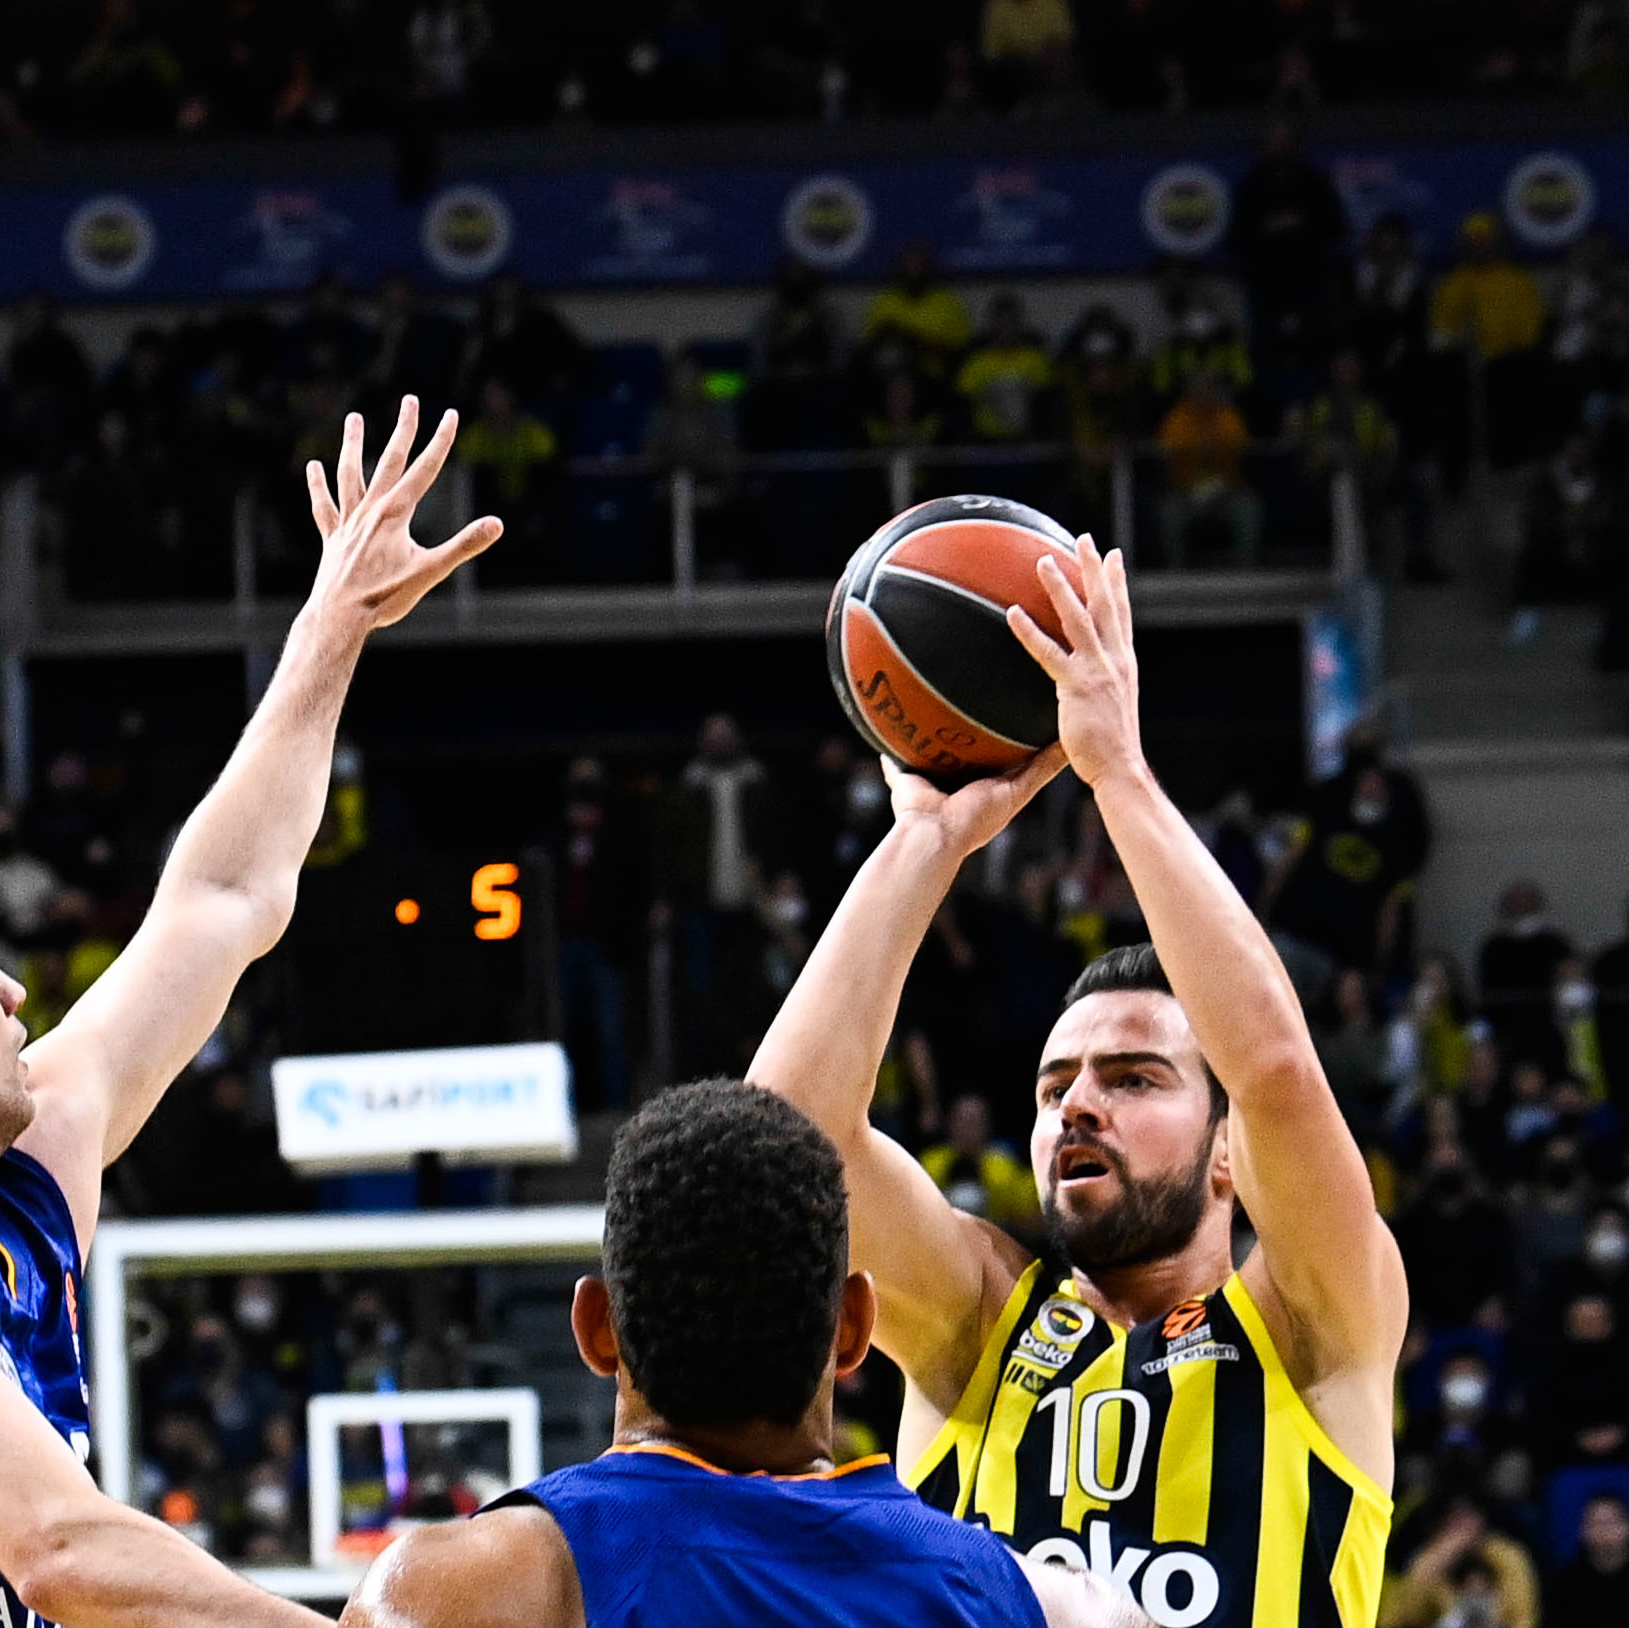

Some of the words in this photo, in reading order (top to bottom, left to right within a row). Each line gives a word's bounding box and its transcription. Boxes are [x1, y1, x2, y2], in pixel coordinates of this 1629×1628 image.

[471, 863, 521, 940] 5
[1019, 1328, 1073, 1364] beko
[1036, 1386, 1150, 1500] 10
[1027, 1521, 1219, 1628] ko
